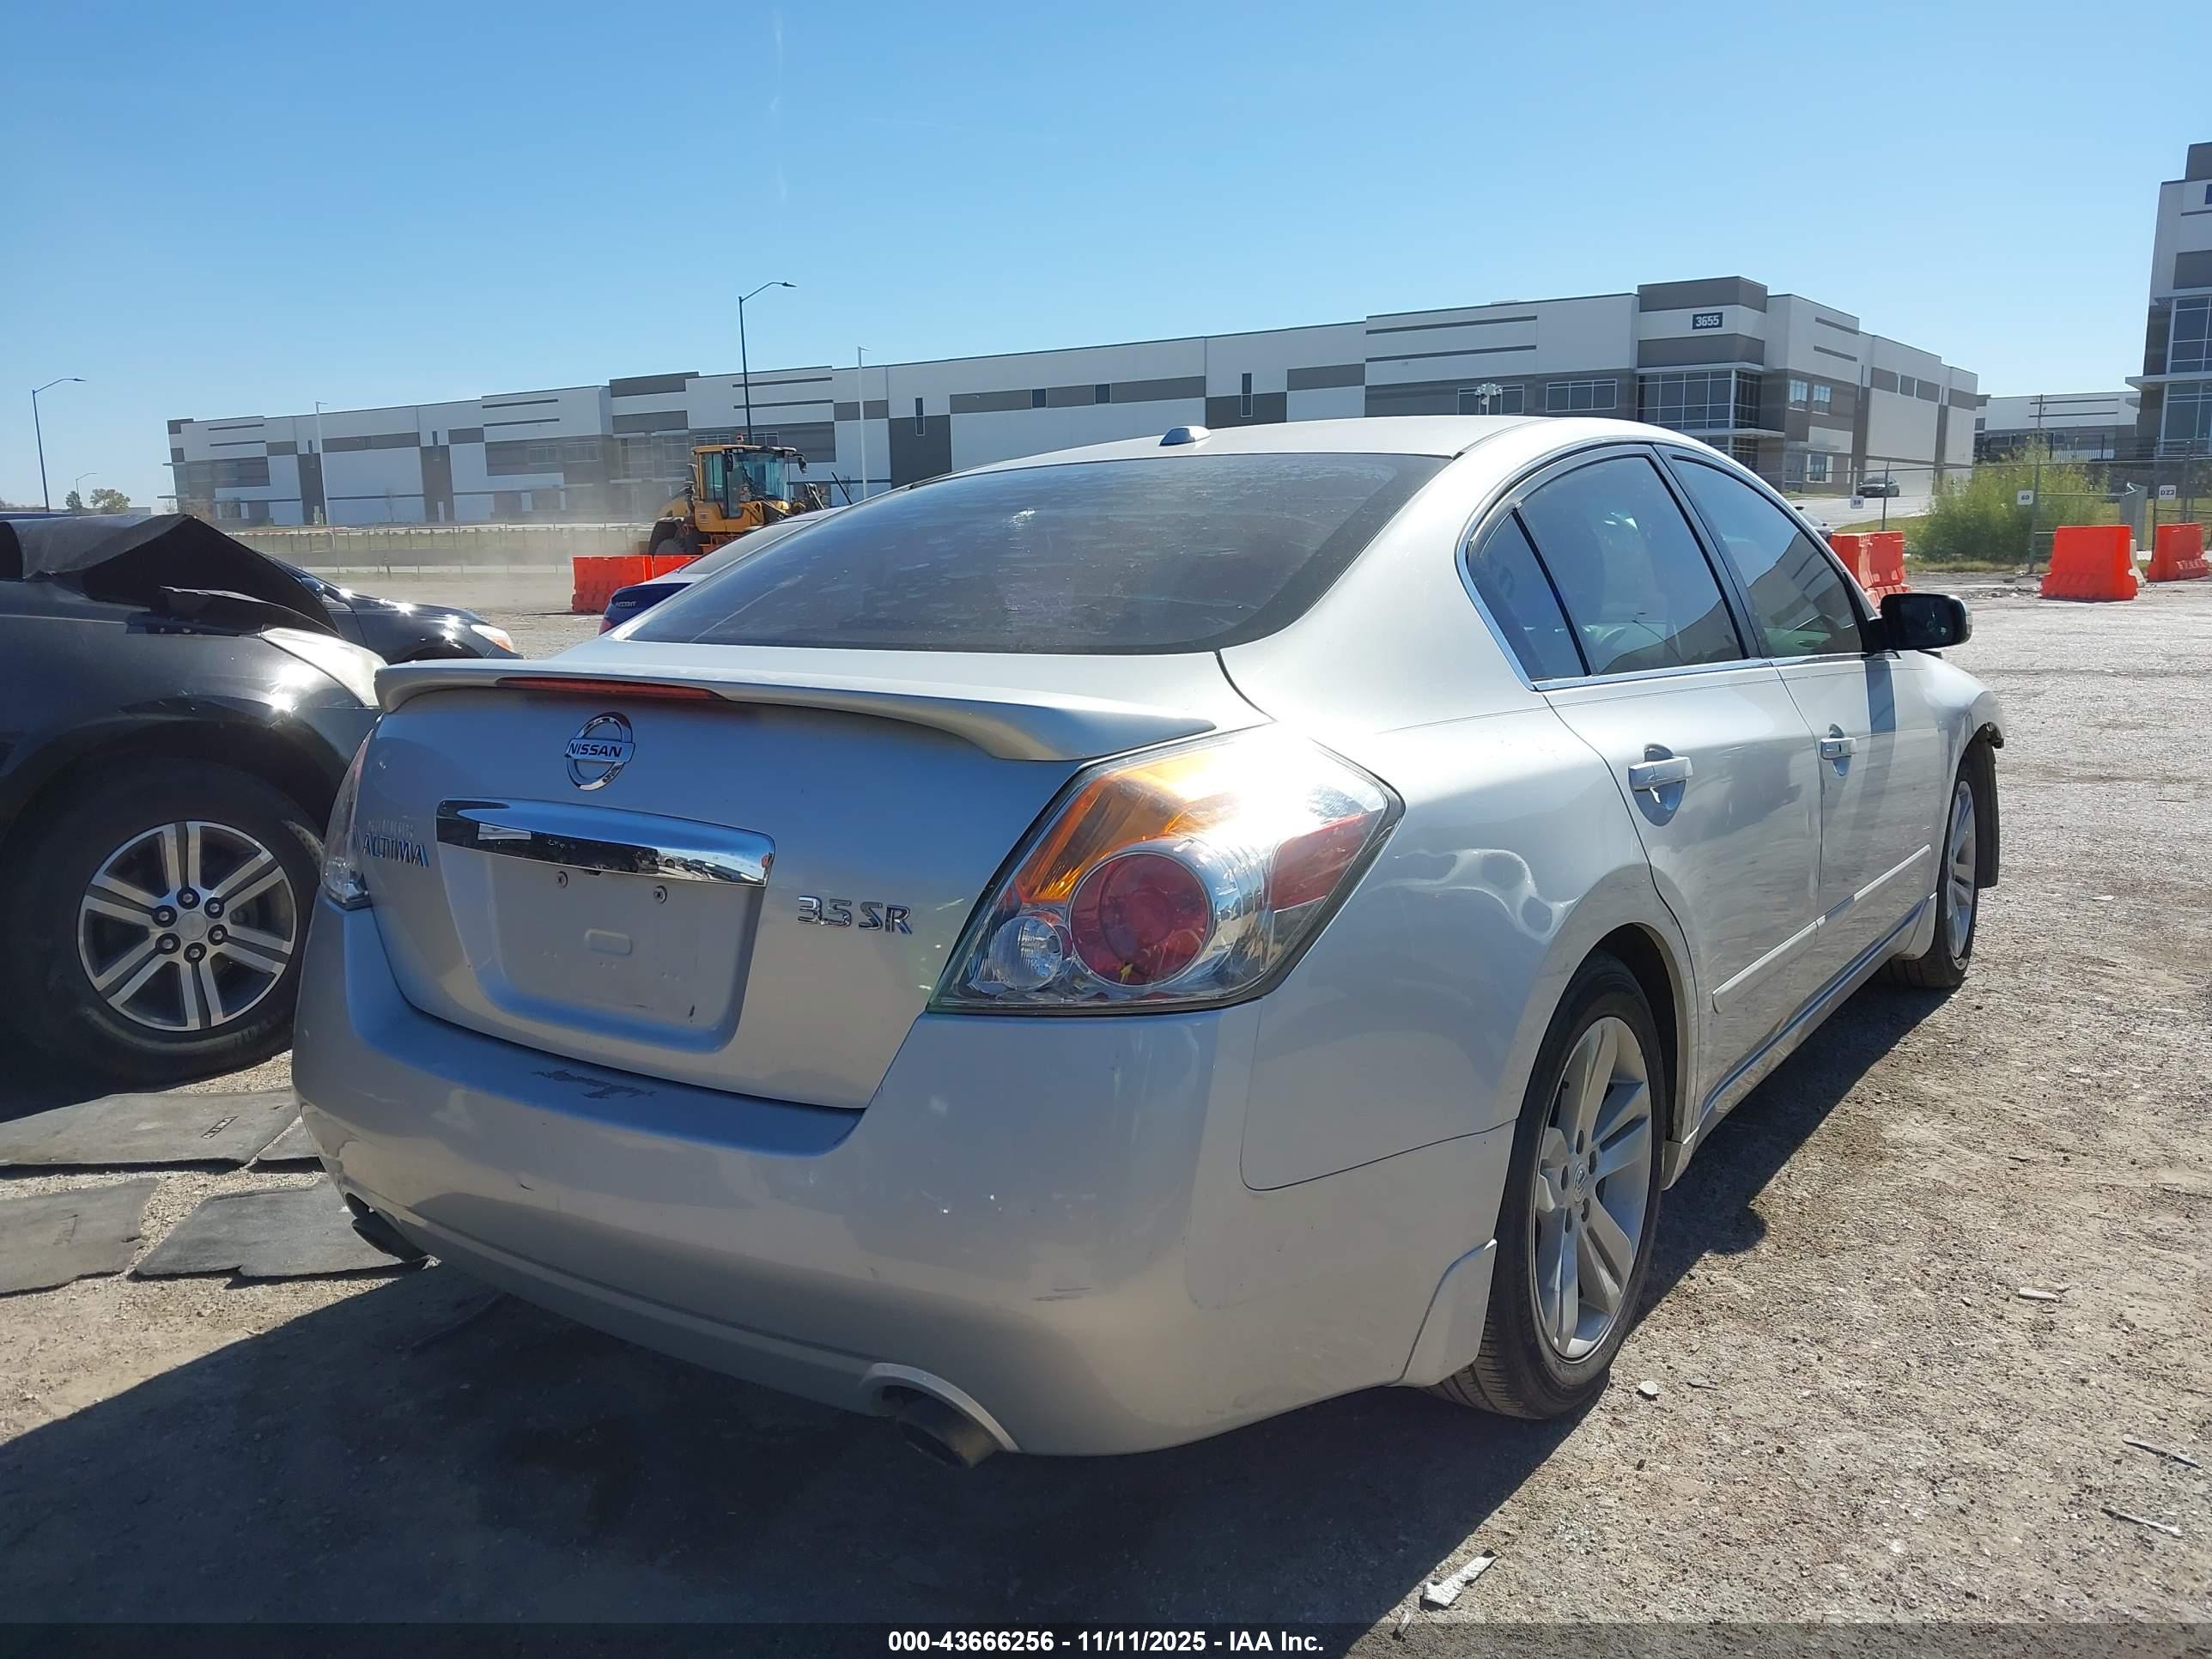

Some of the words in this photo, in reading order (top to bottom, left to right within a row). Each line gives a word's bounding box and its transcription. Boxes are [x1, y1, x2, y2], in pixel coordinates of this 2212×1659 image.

[1695, 314, 1720, 327] 3655
[568, 742, 623, 757] NISSAN
[363, 833, 429, 868] ALTIMA
[858, 902, 913, 935] SR
